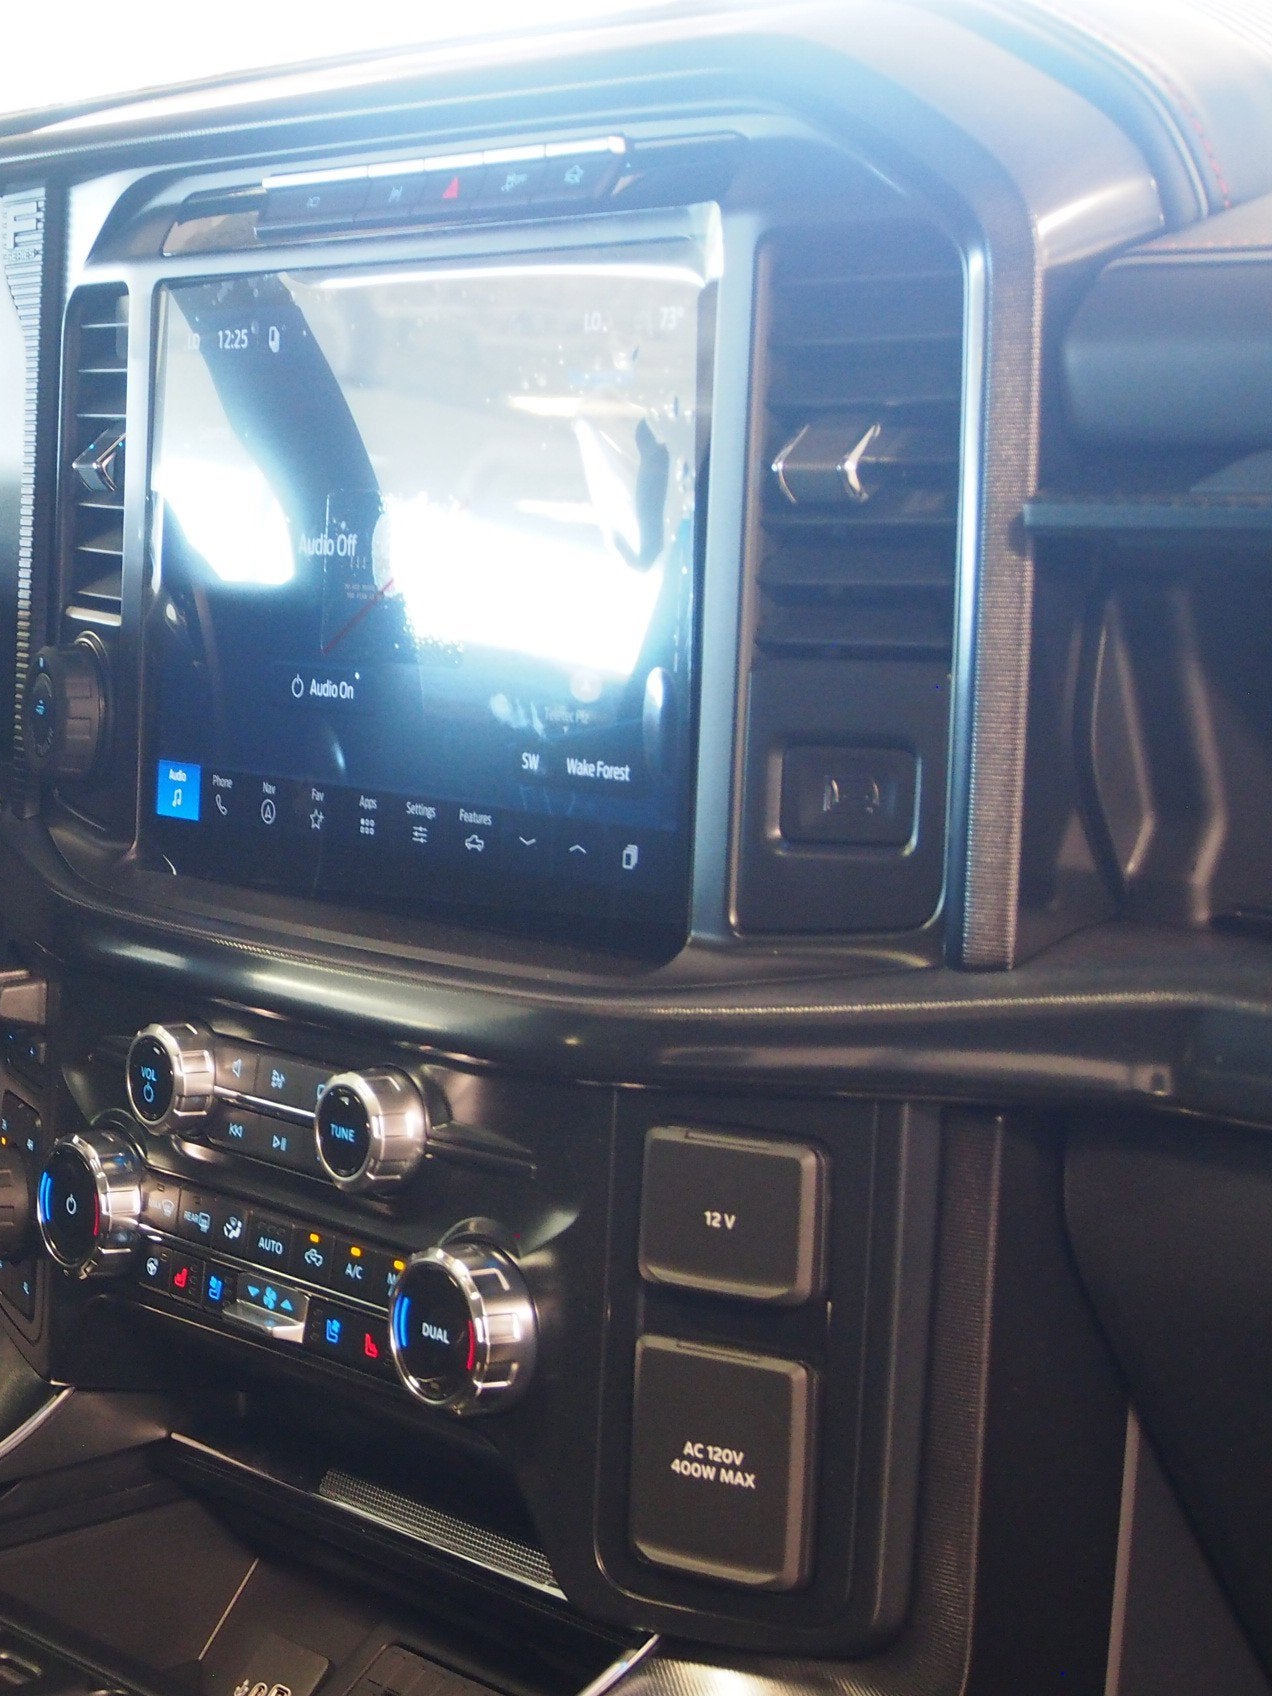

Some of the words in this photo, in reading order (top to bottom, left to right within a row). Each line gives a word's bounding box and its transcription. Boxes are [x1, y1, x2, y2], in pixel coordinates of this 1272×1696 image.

[217, 328, 249, 350] 12:25
[298, 533, 335, 556] Audio
[336, 533, 359, 557] Off
[309, 678, 338, 698] Audio
[338, 680, 355, 699] On
[521, 752, 540, 771] SW
[566, 757, 595, 777] Wake
[596, 760, 630, 781] Forest
[168, 768, 187, 782] Audio
[212, 774, 234, 789] Phone
[262, 781, 277, 795] Nav
[311, 788, 325, 802] Fav
[358, 795, 378, 811] Apps
[406, 801, 437, 820] Settings
[459, 808, 493, 826] Features
[140, 1066, 158, 1083] VOL
[330, 1122, 356, 1143] TUNE
[257, 1236, 284, 1256] AUTO
[344, 1262, 364, 1281] A/C
[421, 1321, 451, 1345] DUAL
[682, 1440, 705, 1459] AC
[706, 1444, 745, 1467] 120V
[670, 1458, 717, 1482] 400W
[719, 1467, 756, 1490] MAX
